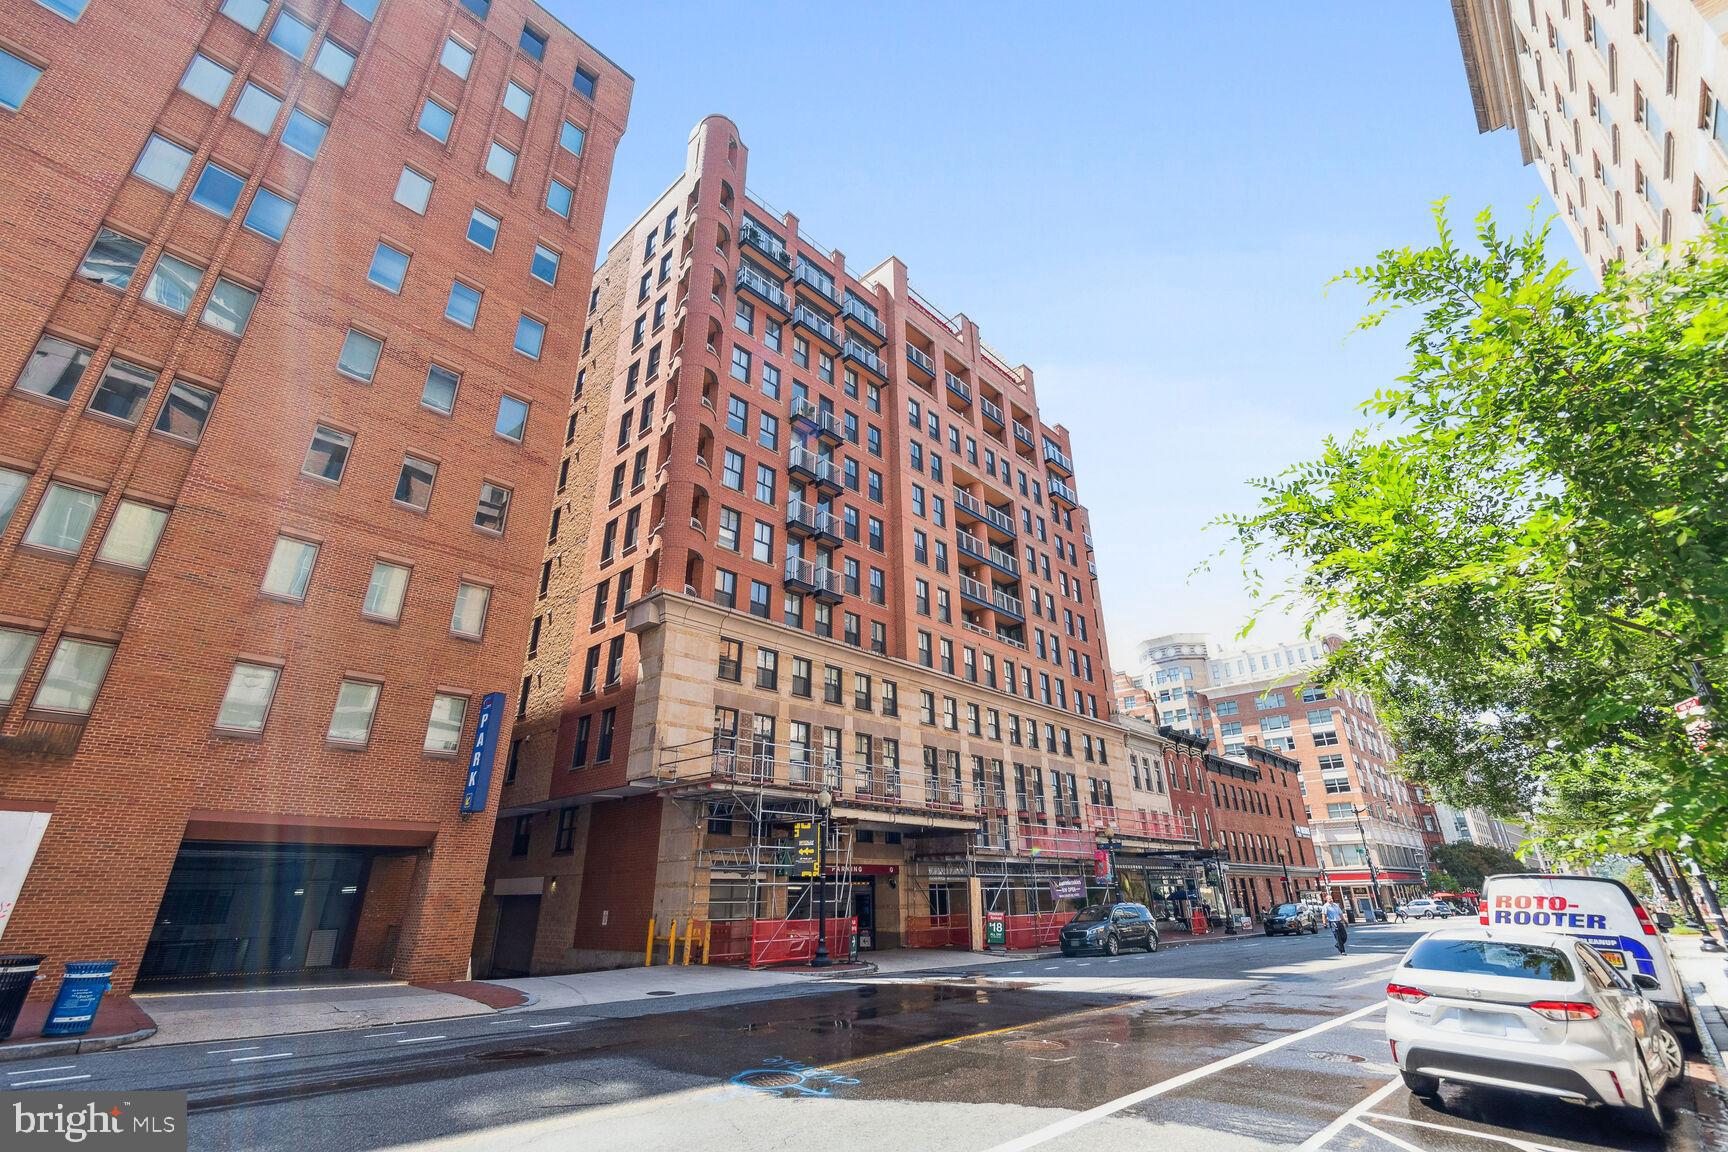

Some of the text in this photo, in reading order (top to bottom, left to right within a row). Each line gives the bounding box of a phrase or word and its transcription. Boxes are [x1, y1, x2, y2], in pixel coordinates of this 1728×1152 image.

[469, 713, 488, 786] PARK
[1495, 895, 1579, 911] ROTO-
[1495, 910, 1606, 930] ROOTER
